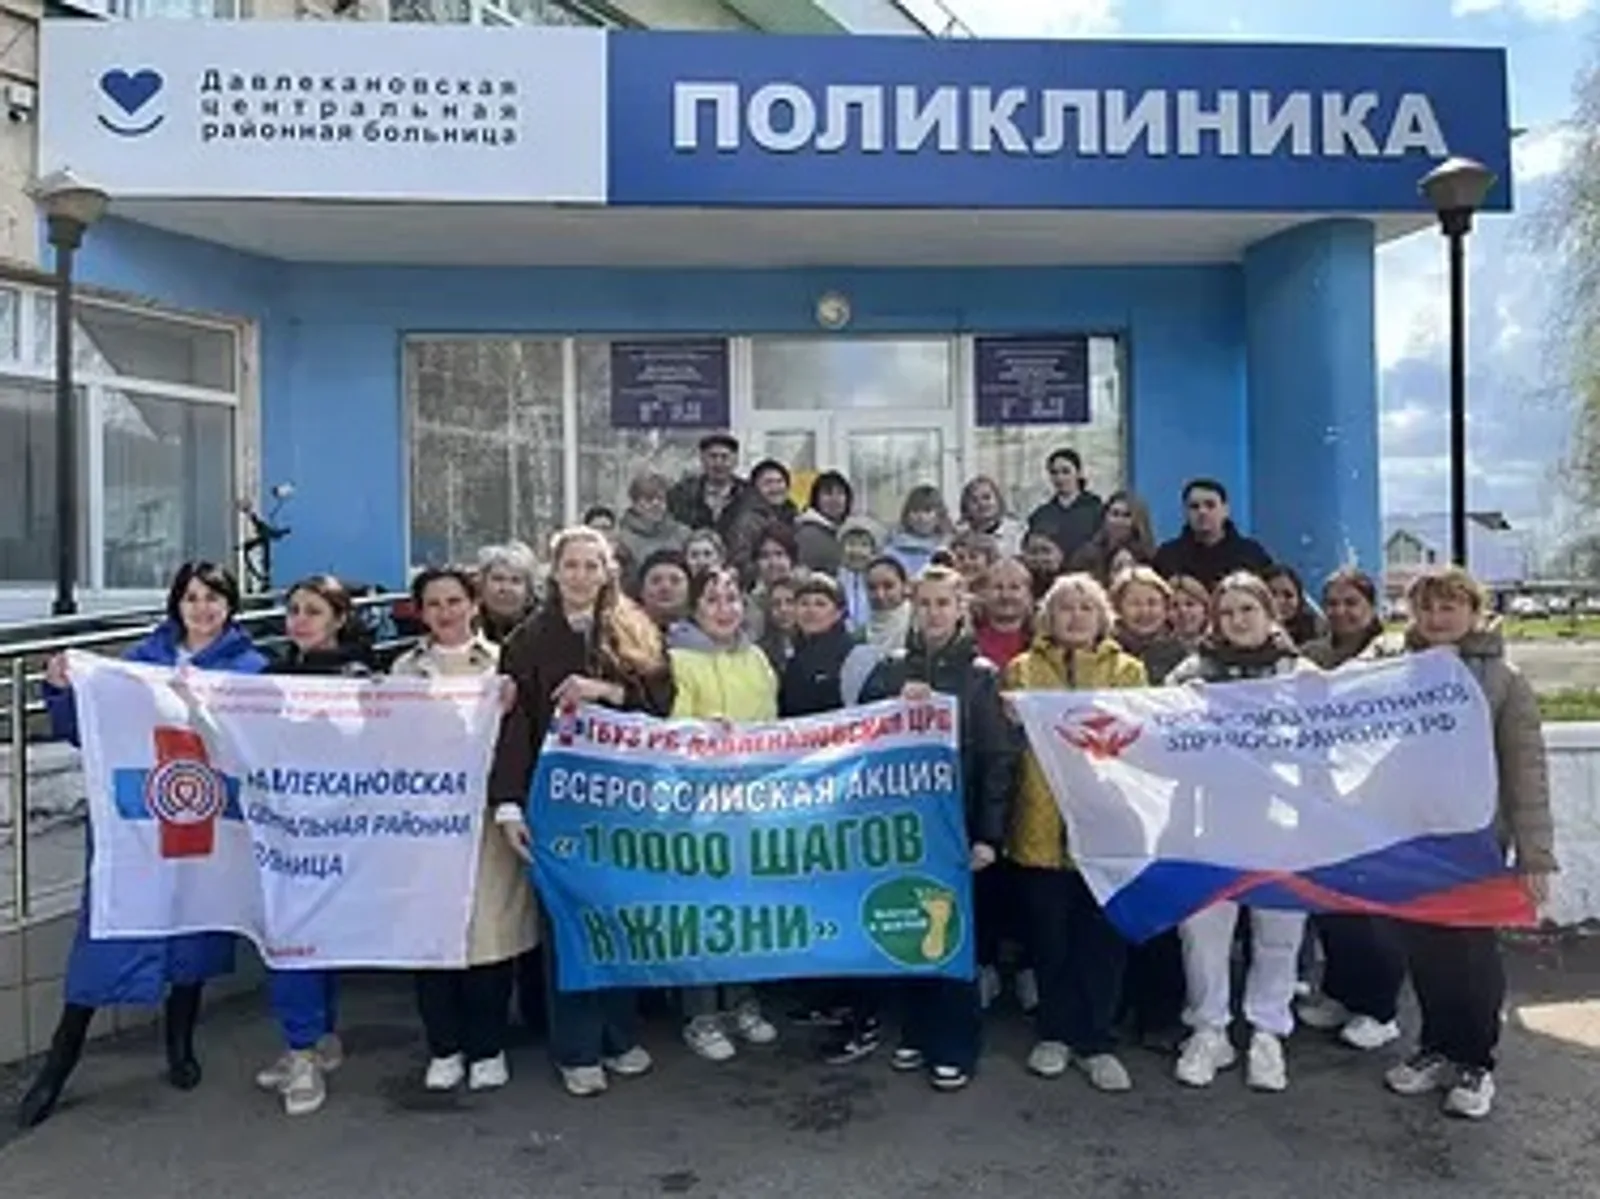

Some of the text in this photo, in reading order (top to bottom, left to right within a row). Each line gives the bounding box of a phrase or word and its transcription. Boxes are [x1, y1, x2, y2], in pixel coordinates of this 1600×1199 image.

[200, 69, 517, 95] Давлекановская
[202, 98, 517, 119] центральная
[673, 83, 1447, 155] ПОЛИКЛИНИКА
[202, 120, 517, 145] районная больница
[589, 718, 641, 748] ГБУЗ
[908, 705, 952, 732] ЦРБ
[1420, 713, 1456, 734] РФ
[845, 762, 954, 799] АКЦИЯ
[372, 811, 471, 837] РАЙОННАЯ
[750, 810, 924, 876] ШАГОВ
